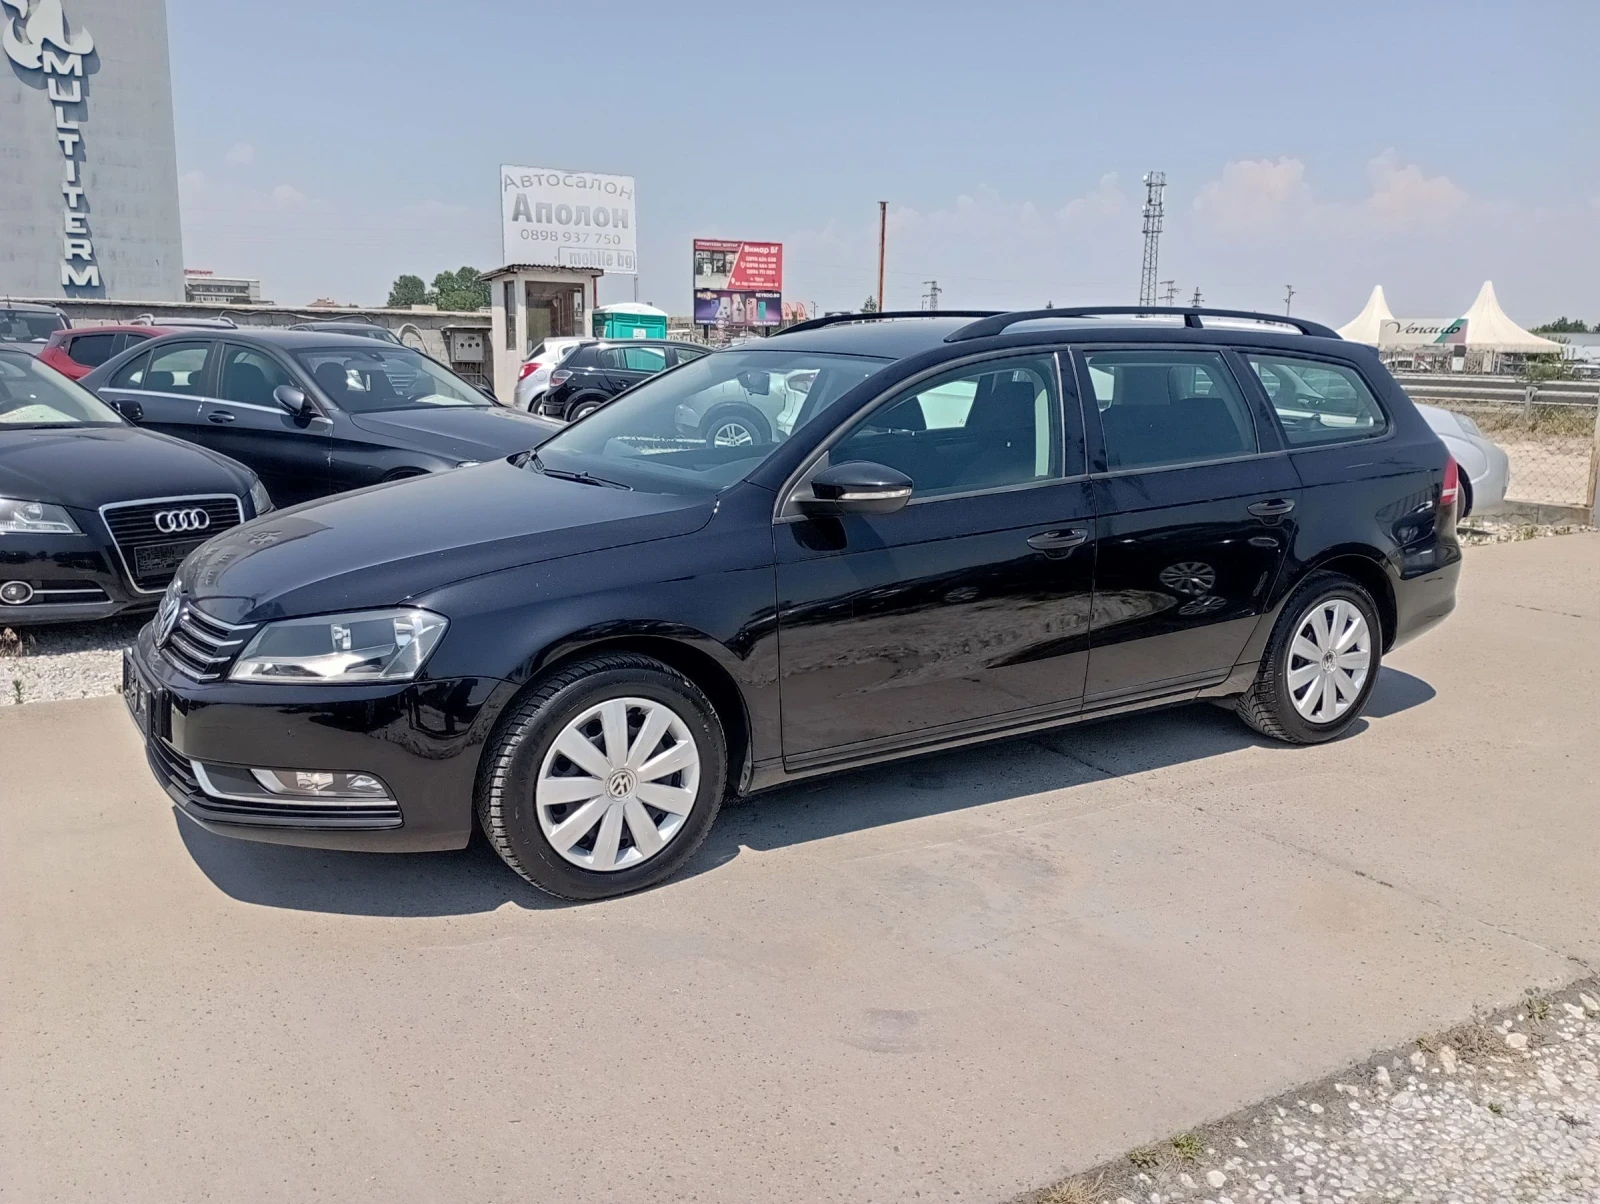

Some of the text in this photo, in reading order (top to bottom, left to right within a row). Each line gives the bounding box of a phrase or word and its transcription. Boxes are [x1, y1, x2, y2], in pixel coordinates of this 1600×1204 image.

[42, 50, 100, 287] MULTITERM
[504, 173, 633, 200] Автосалон
[511, 193, 629, 229] Аполон
[520, 229, 621, 245] 0898 937 750
[744, 245, 769, 254] Вимар
